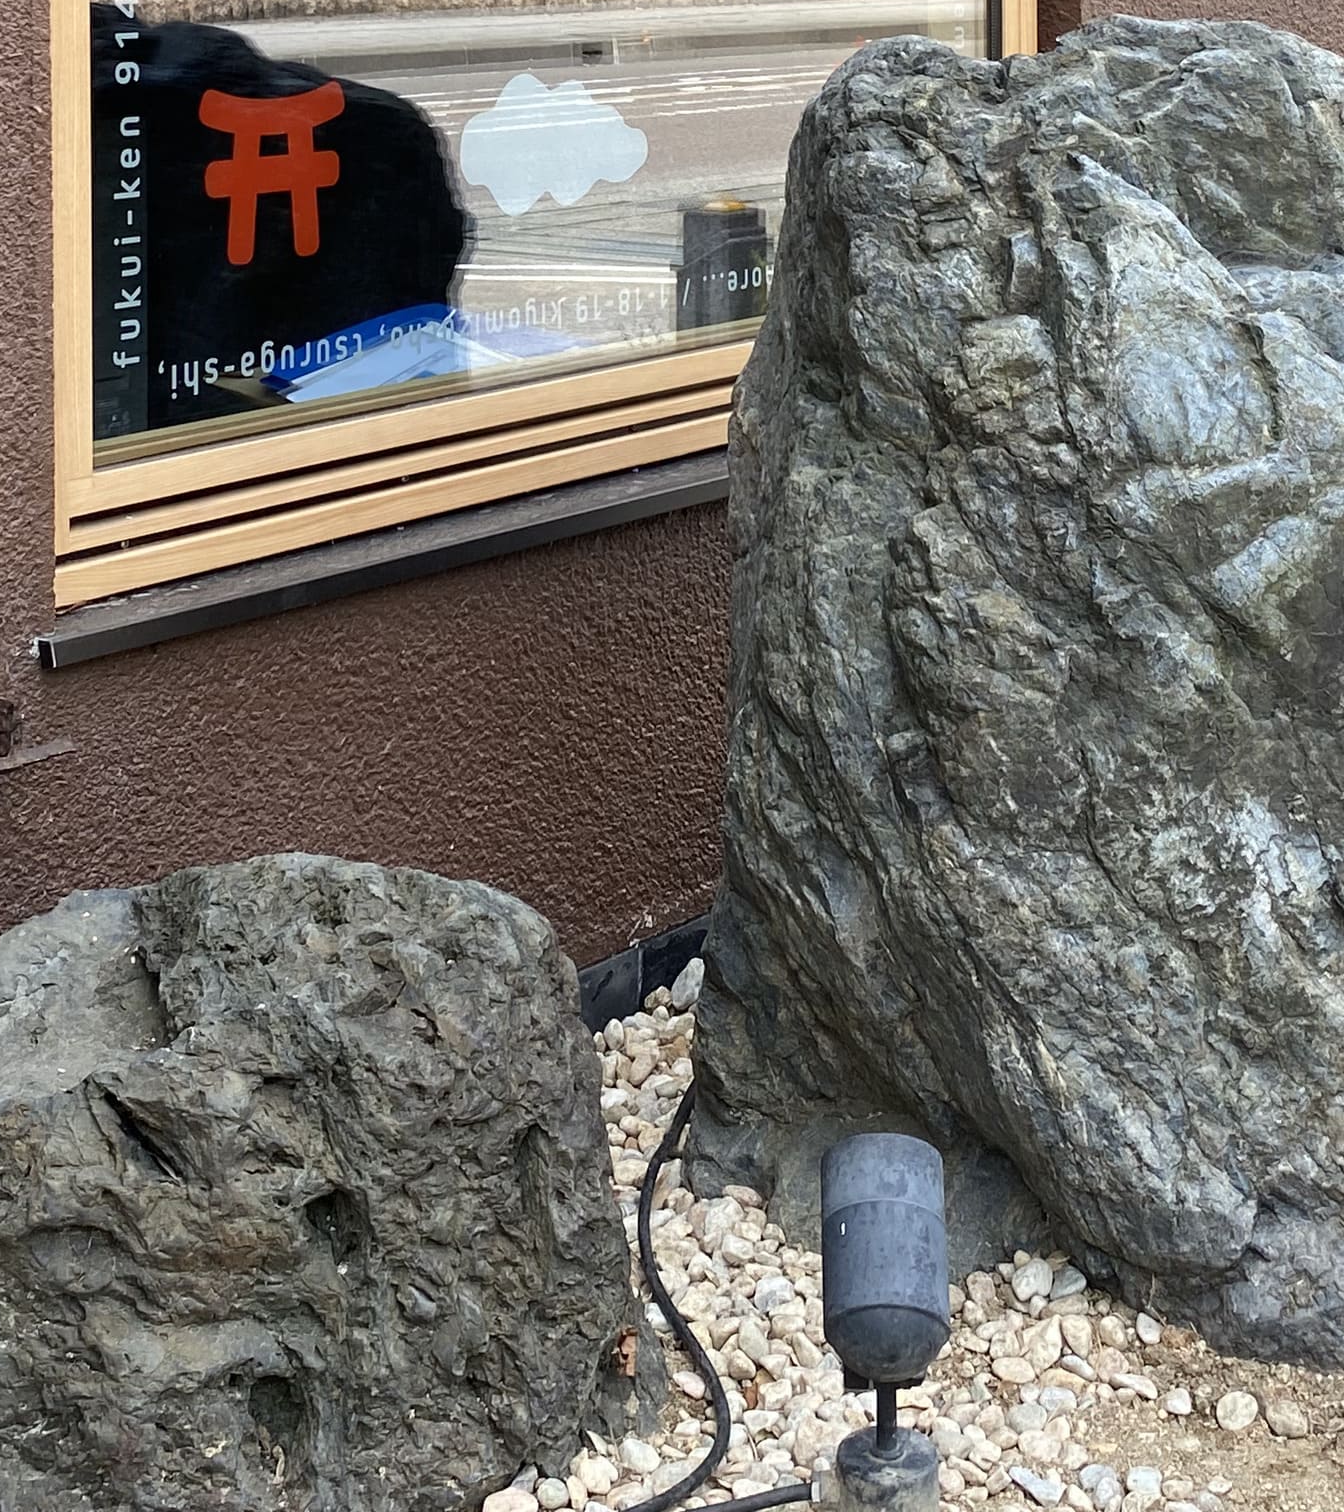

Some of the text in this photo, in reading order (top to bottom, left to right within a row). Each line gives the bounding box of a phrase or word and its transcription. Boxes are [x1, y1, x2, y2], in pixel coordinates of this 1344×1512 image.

[113, 115, 142, 368] fukui-ken
[575, 285, 668, 324] 1-18-19
[158, 333, 363, 400] tsuruga-shi,
